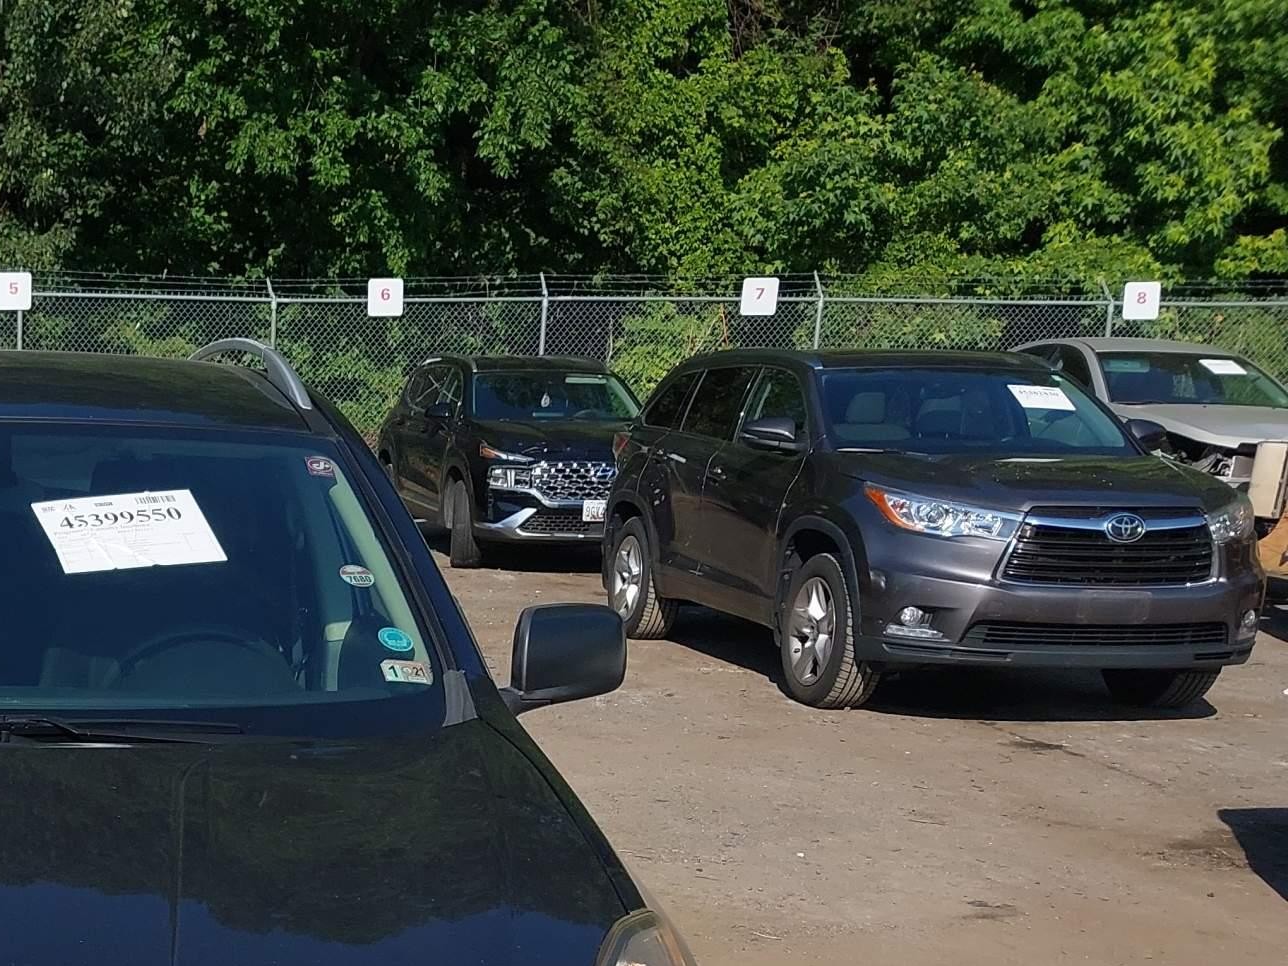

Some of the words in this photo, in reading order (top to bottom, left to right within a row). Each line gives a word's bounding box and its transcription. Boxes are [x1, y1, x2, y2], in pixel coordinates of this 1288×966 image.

[9, 282, 18, 295] 5
[381, 287, 391, 301] 6
[756, 287, 765, 300] 7
[1137, 291, 1147, 304] 8
[59, 506, 183, 530] 45399550
[388, 664, 399, 678] 1
[412, 666, 426, 677] 21
